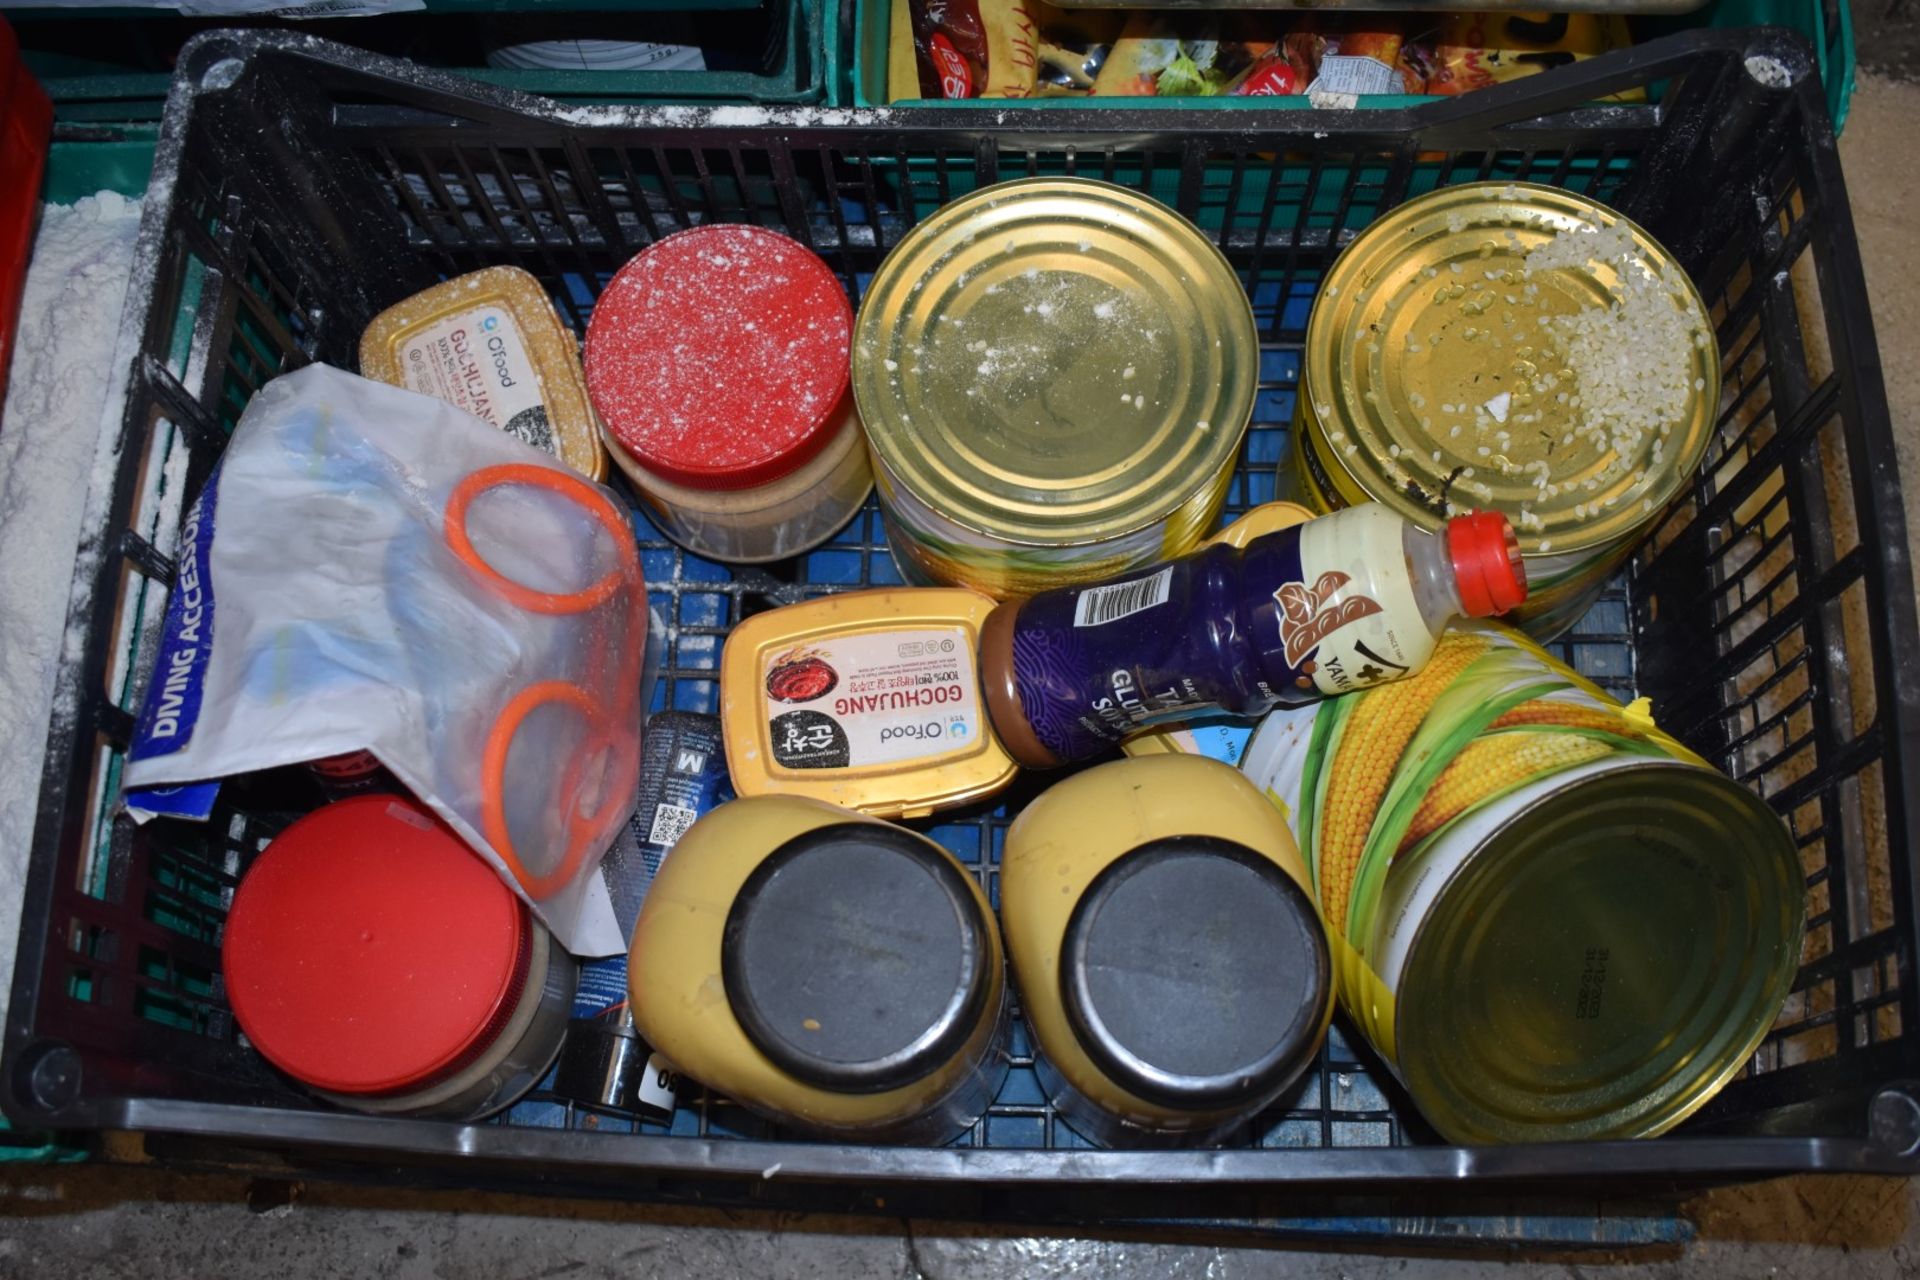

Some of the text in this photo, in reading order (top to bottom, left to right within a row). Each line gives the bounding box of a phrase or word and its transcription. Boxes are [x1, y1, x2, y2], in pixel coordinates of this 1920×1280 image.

[933, 670, 960, 683] 100%
[152, 647, 196, 739] DIVING
[834, 684, 963, 716] GOCHUJANG
[780, 724, 835, 754] 순창
[880, 721, 942, 744] O'Food
